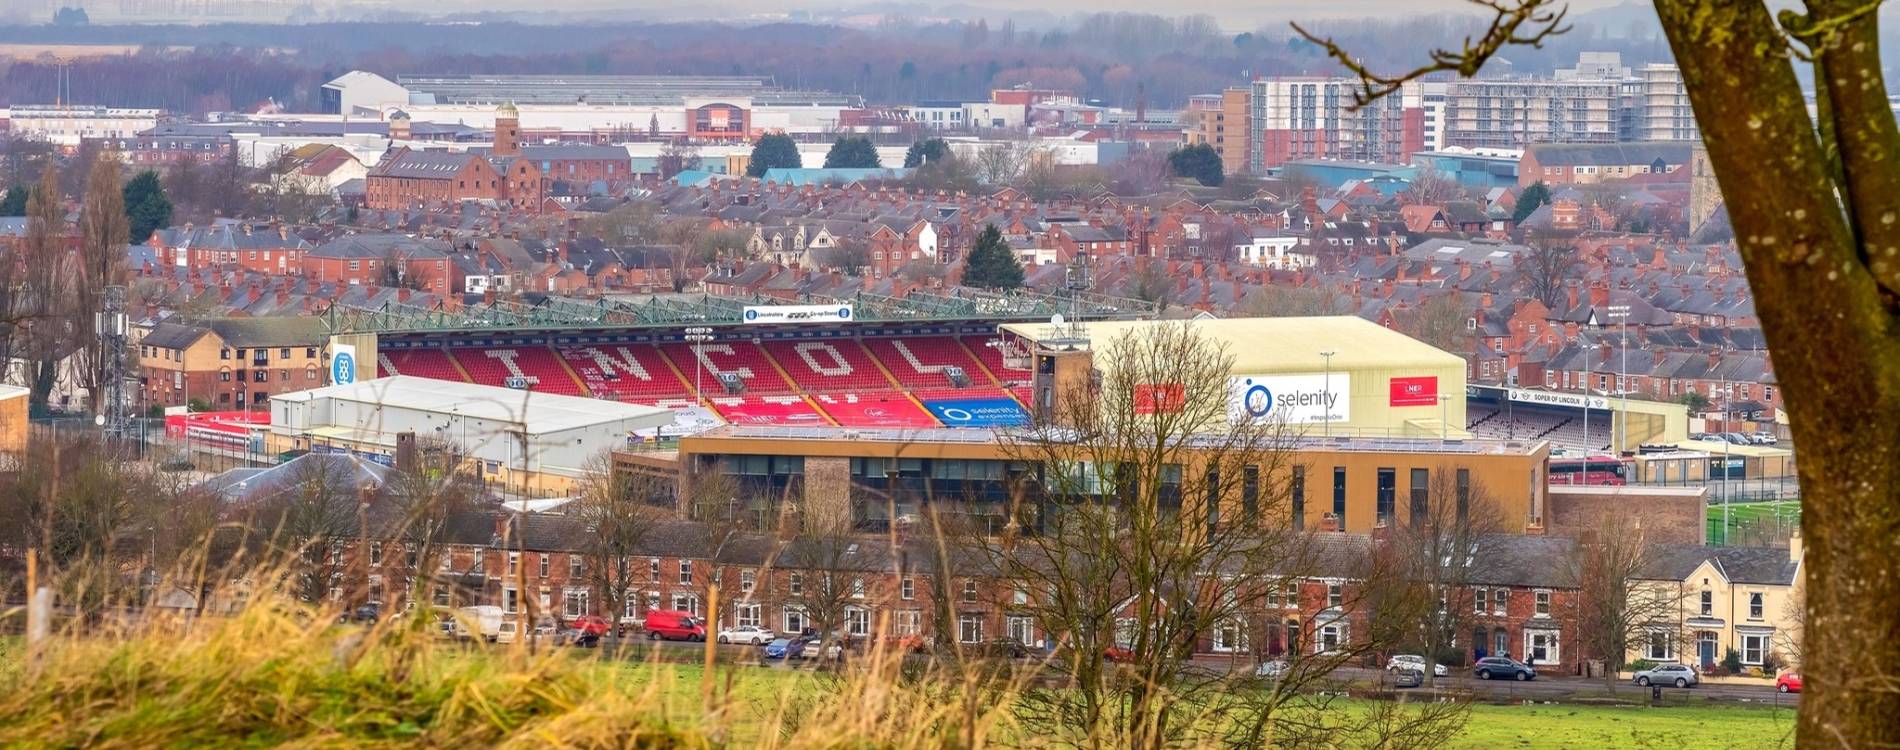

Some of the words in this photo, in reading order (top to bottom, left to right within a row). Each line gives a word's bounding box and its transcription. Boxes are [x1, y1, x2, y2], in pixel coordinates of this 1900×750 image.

[1277, 389, 1338, 409] selenity
[1534, 393, 1551, 402] SOPER
[1559, 396, 1580, 405] LINCOLN
